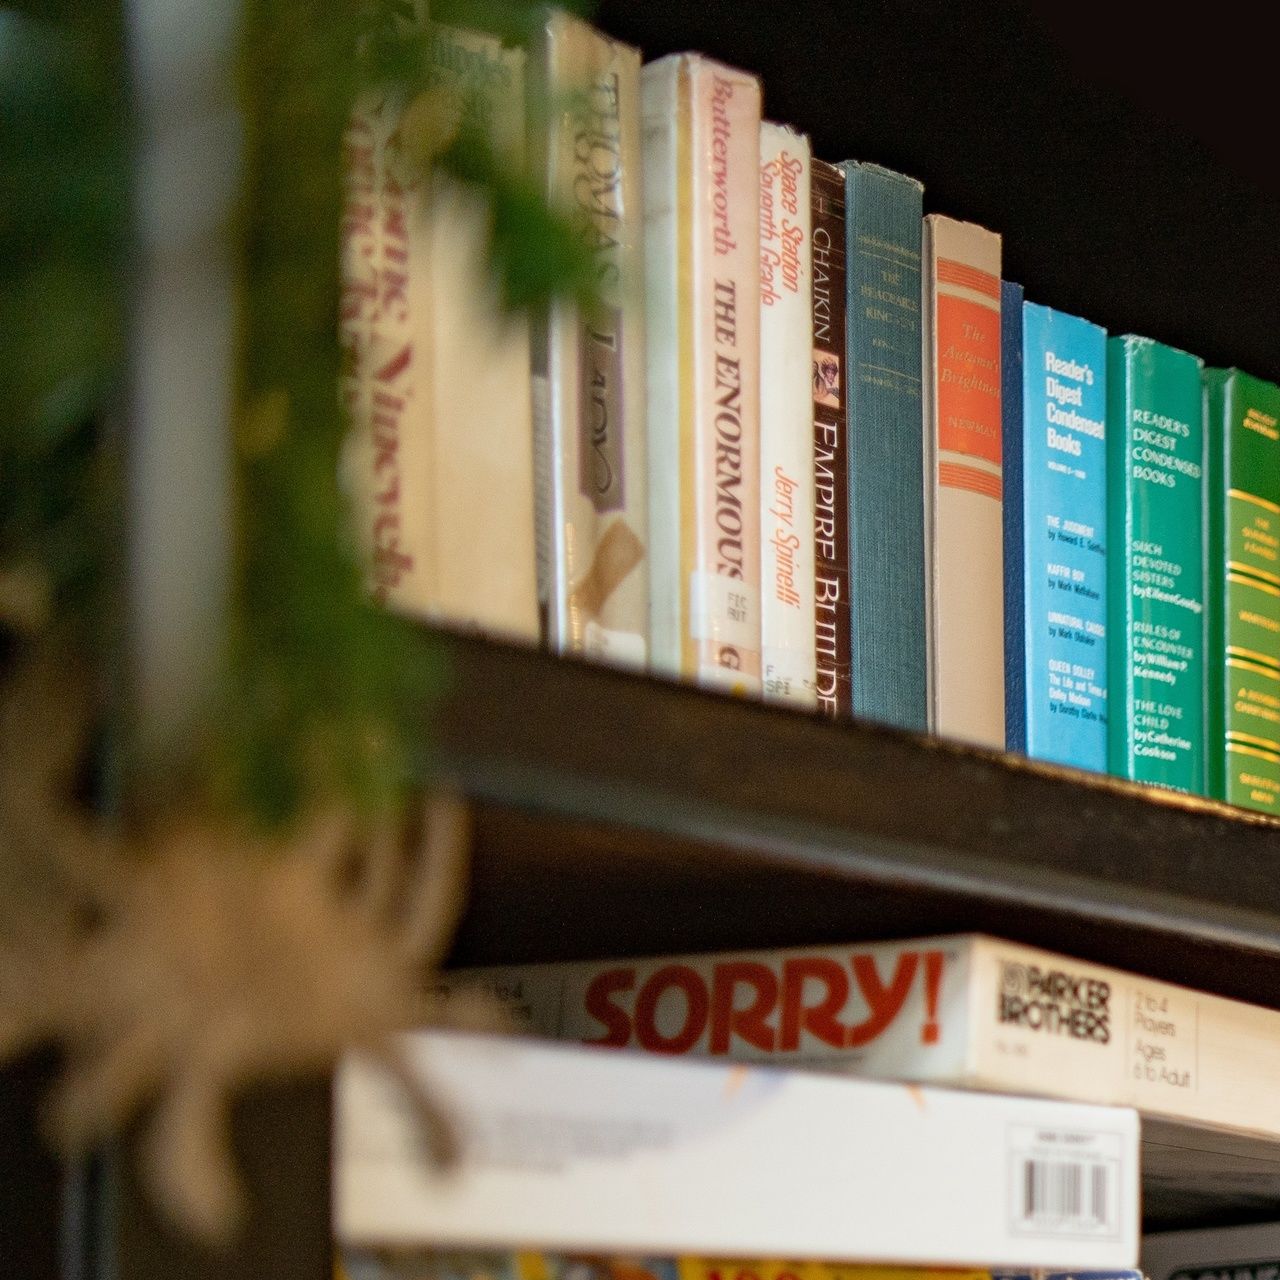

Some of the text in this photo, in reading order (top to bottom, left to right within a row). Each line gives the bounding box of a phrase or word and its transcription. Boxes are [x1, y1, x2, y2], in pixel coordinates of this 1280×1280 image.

[712, 75, 736, 256] Butterworth
[761, 161, 779, 240] Seventh
[780, 151, 804, 293] Space Station
[813, 227, 831, 341] CHAIKIN
[962, 323, 986, 343] The
[1045, 351, 1094, 386] Reader's
[1046, 376, 1082, 407] Digest
[714, 280, 743, 581] THE ENORMOUS
[949, 417, 999, 441] NEWMAN
[1047, 402, 1106, 440] Condensed
[1133, 409, 1190, 438] READERS
[1047, 427, 1082, 457] Books
[1133, 428, 1177, 451] DIGEST
[1132, 446, 1201, 479] CONDENSED
[814, 421, 839, 560] EMPIRE
[1133, 466, 1176, 489] BOOKS
[769, 466, 801, 610] Jerry Spinelli
[1131, 541, 1163, 556] SUCH
[1133, 555, 1182, 577] DEVOTED
[1134, 665, 1176, 687] Kennedy
[1134, 699, 1183, 721] THE LOVE
[1134, 713, 1169, 731] CHILD
[1134, 743, 1177, 763] Cookson
[1148, 730, 1192, 752] Catherine
[1027, 965, 1111, 1011] PARKER
[583, 950, 947, 1056] SORRY!
[999, 994, 1111, 1045] BROTHERS
[1136, 1014, 1177, 1037] Players
[1136, 1040, 1166, 1062] Ages
[1159, 1067, 1191, 1088] Adult
